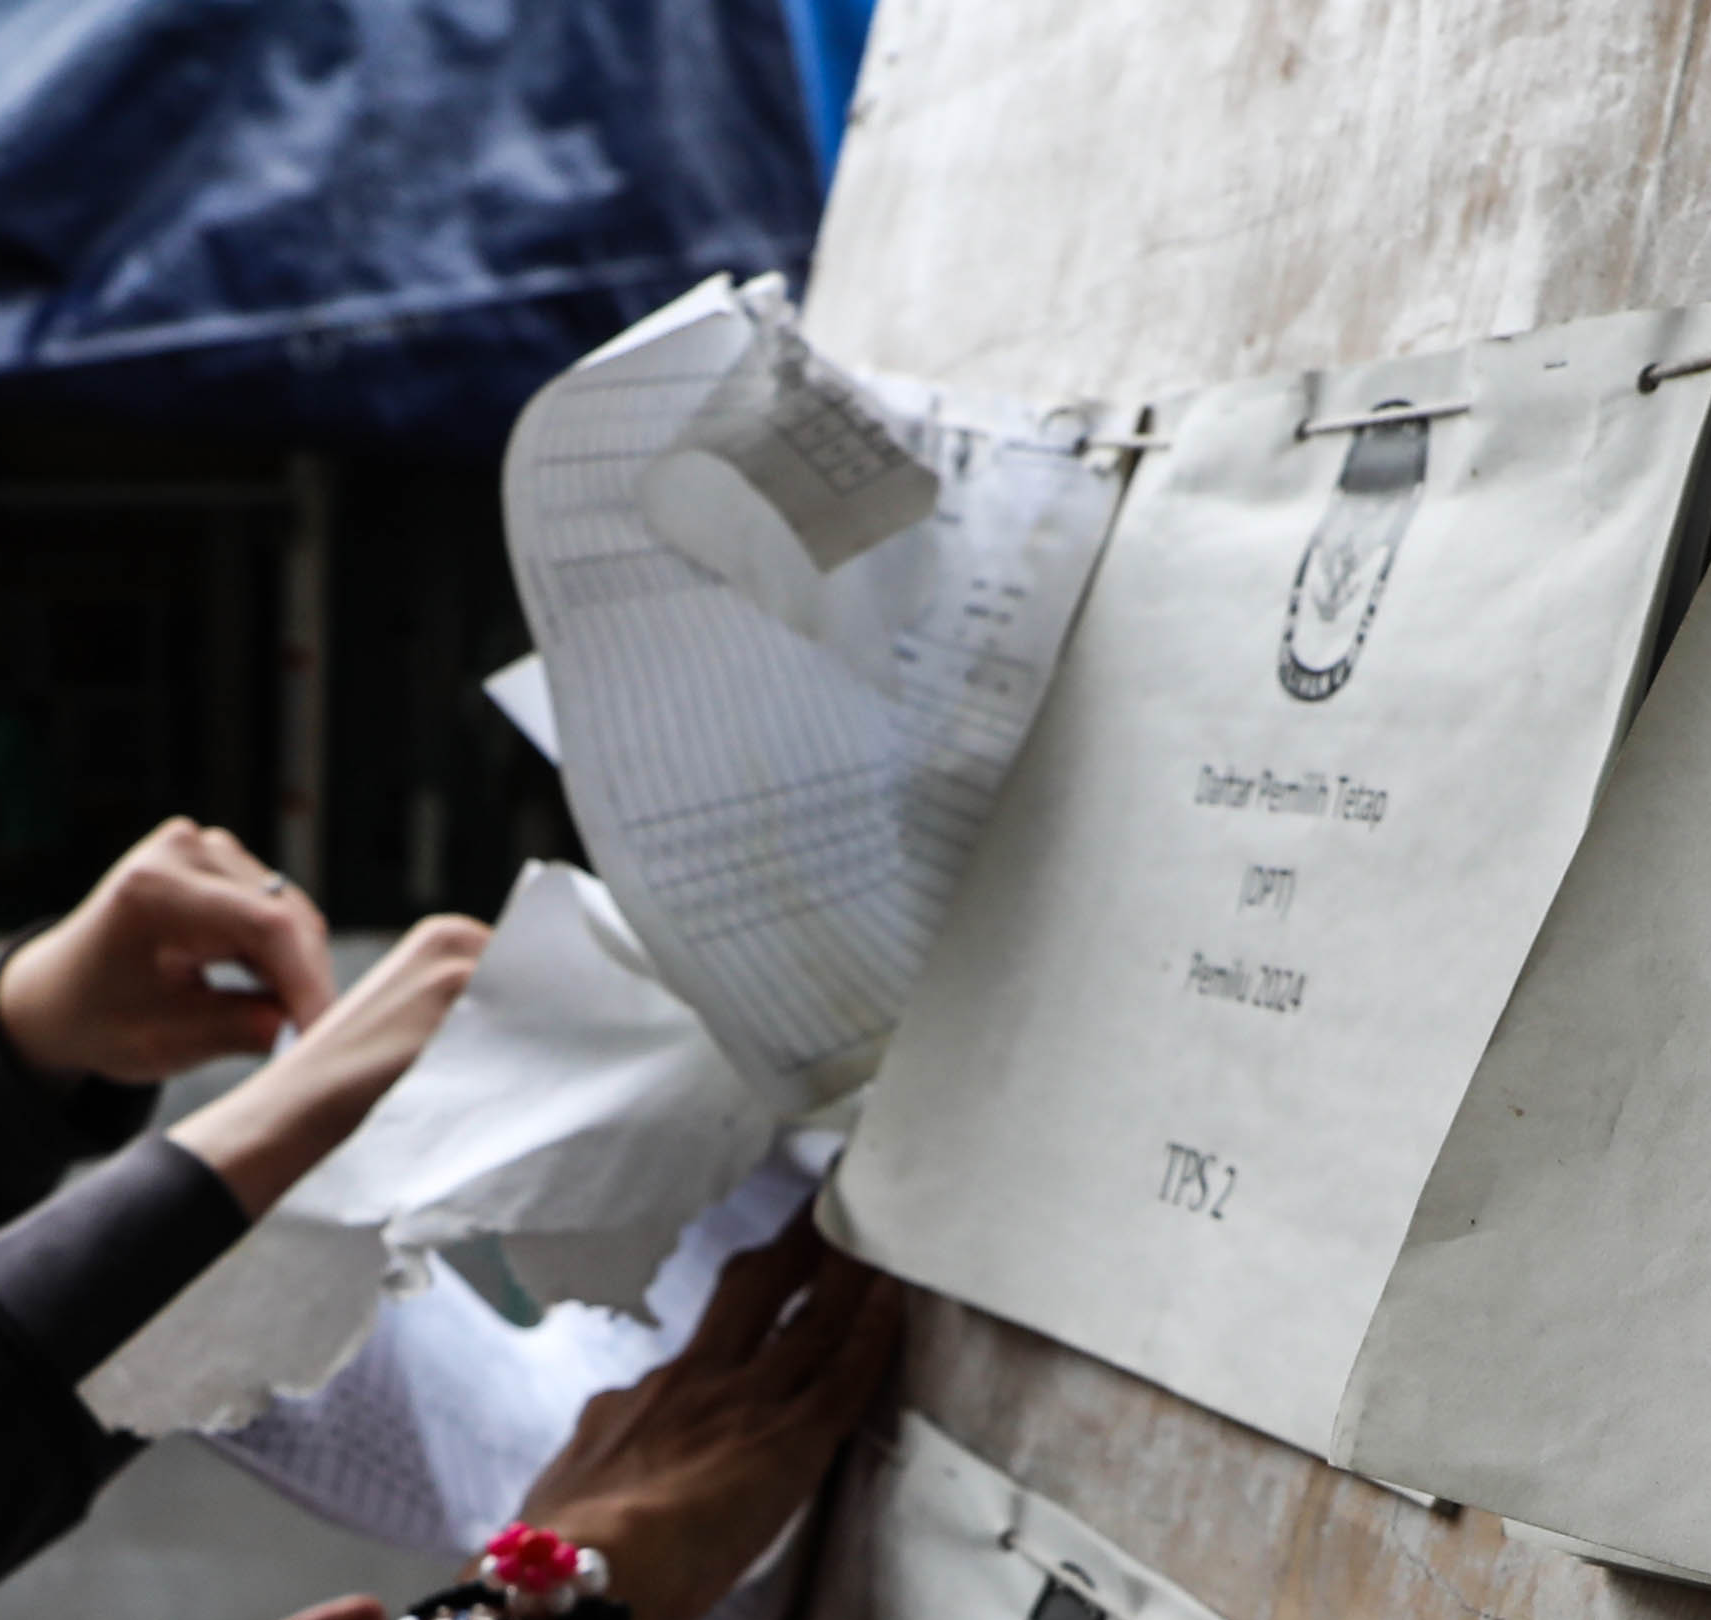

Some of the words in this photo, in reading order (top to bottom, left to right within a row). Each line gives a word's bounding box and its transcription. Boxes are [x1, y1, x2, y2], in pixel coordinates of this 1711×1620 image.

[1194, 764, 1255, 809] Daftar
[1256, 769, 1329, 817] Pemilih
[1332, 774, 1388, 832] Tetap
[1237, 864, 1296, 924] (DPT)
[1183, 949, 1251, 1002] Pemilu
[1251, 963, 1306, 1012] 2024
[1158, 1141, 1218, 1212] TPS
[1210, 1165, 1236, 1220] 2
